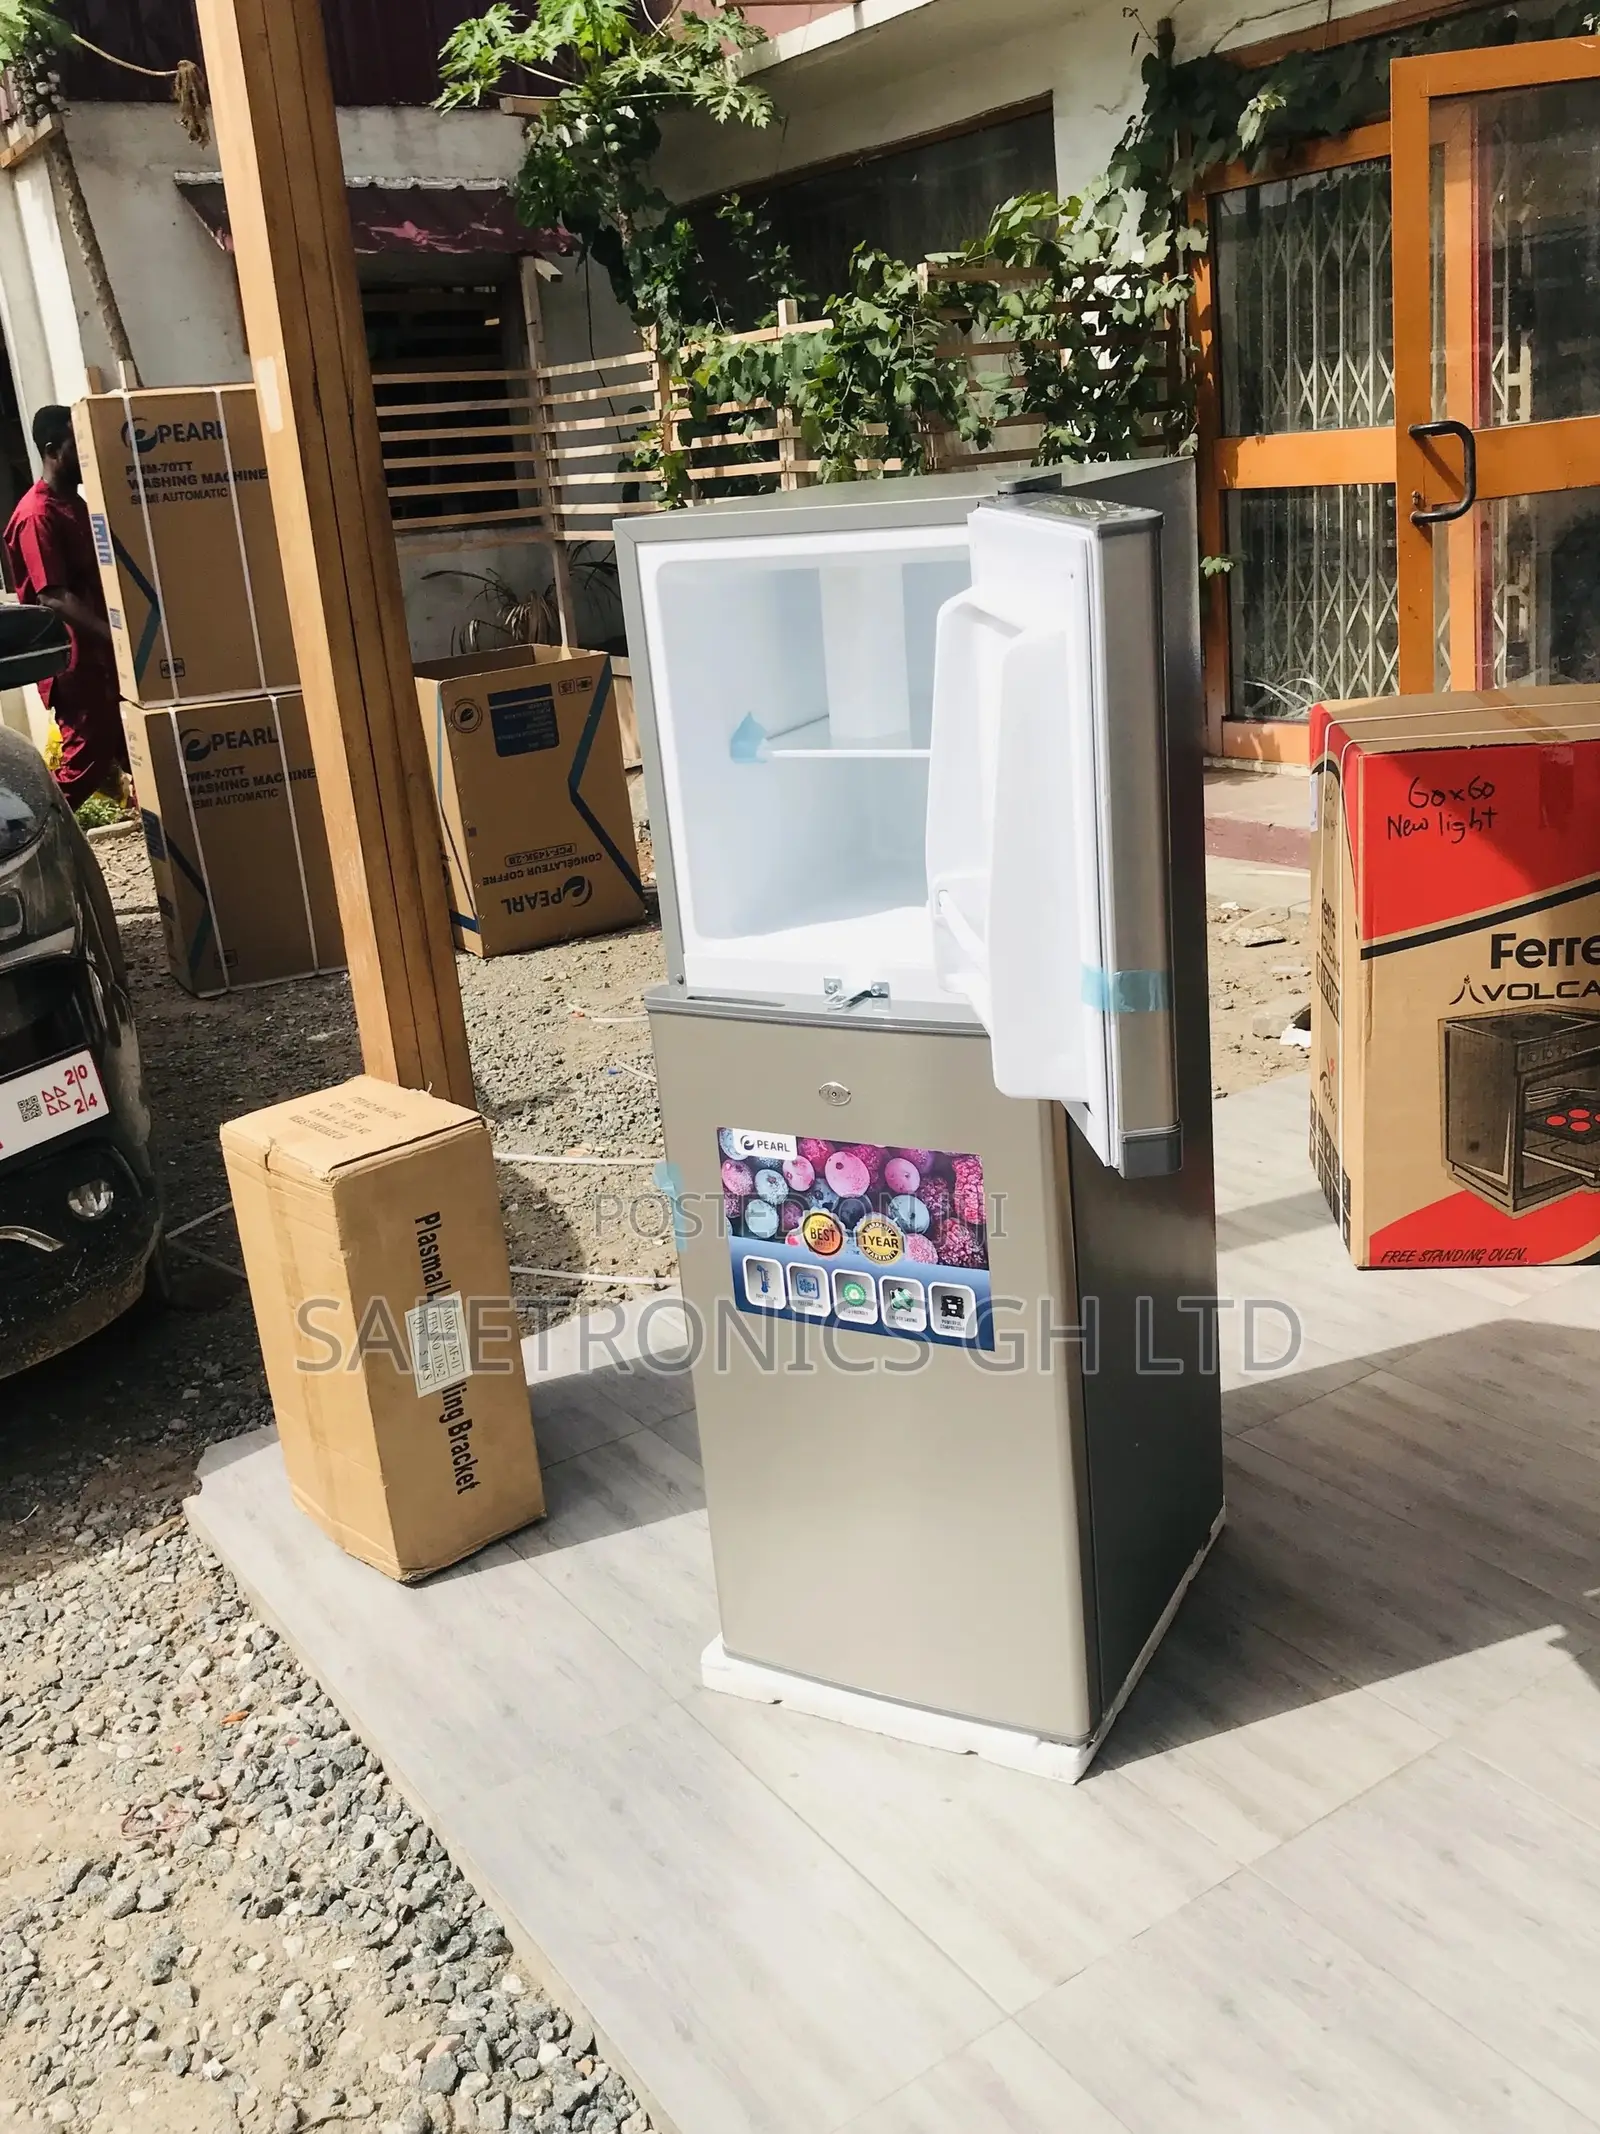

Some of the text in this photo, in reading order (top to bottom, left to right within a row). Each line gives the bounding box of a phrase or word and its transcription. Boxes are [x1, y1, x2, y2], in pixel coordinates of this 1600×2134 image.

[127, 468, 268, 489] WASHING MACHINE
[162, 488, 228, 502] AUTOMATIC
[211, 726, 279, 751] PEARL
[187, 765, 245, 783] WM-70TT
[193, 788, 278, 810] EMI AUTOMATIC
[1387, 806, 1498, 844] New light
[482, 852, 603, 886] CONGÉLATEUR COFFRE
[501, 887, 564, 915] PEARL
[1491, 933, 1600, 969] Ferre
[1481, 980, 1600, 1001] VOLCA
[757, 1140, 791, 1153] PEARL
[810, 1228, 836, 1243] BEST
[868, 1235, 899, 1249] YEAR
[1381, 1247, 1527, 1264] FREE STANDING OVEN
[448, 1419, 482, 1495] Bracket
